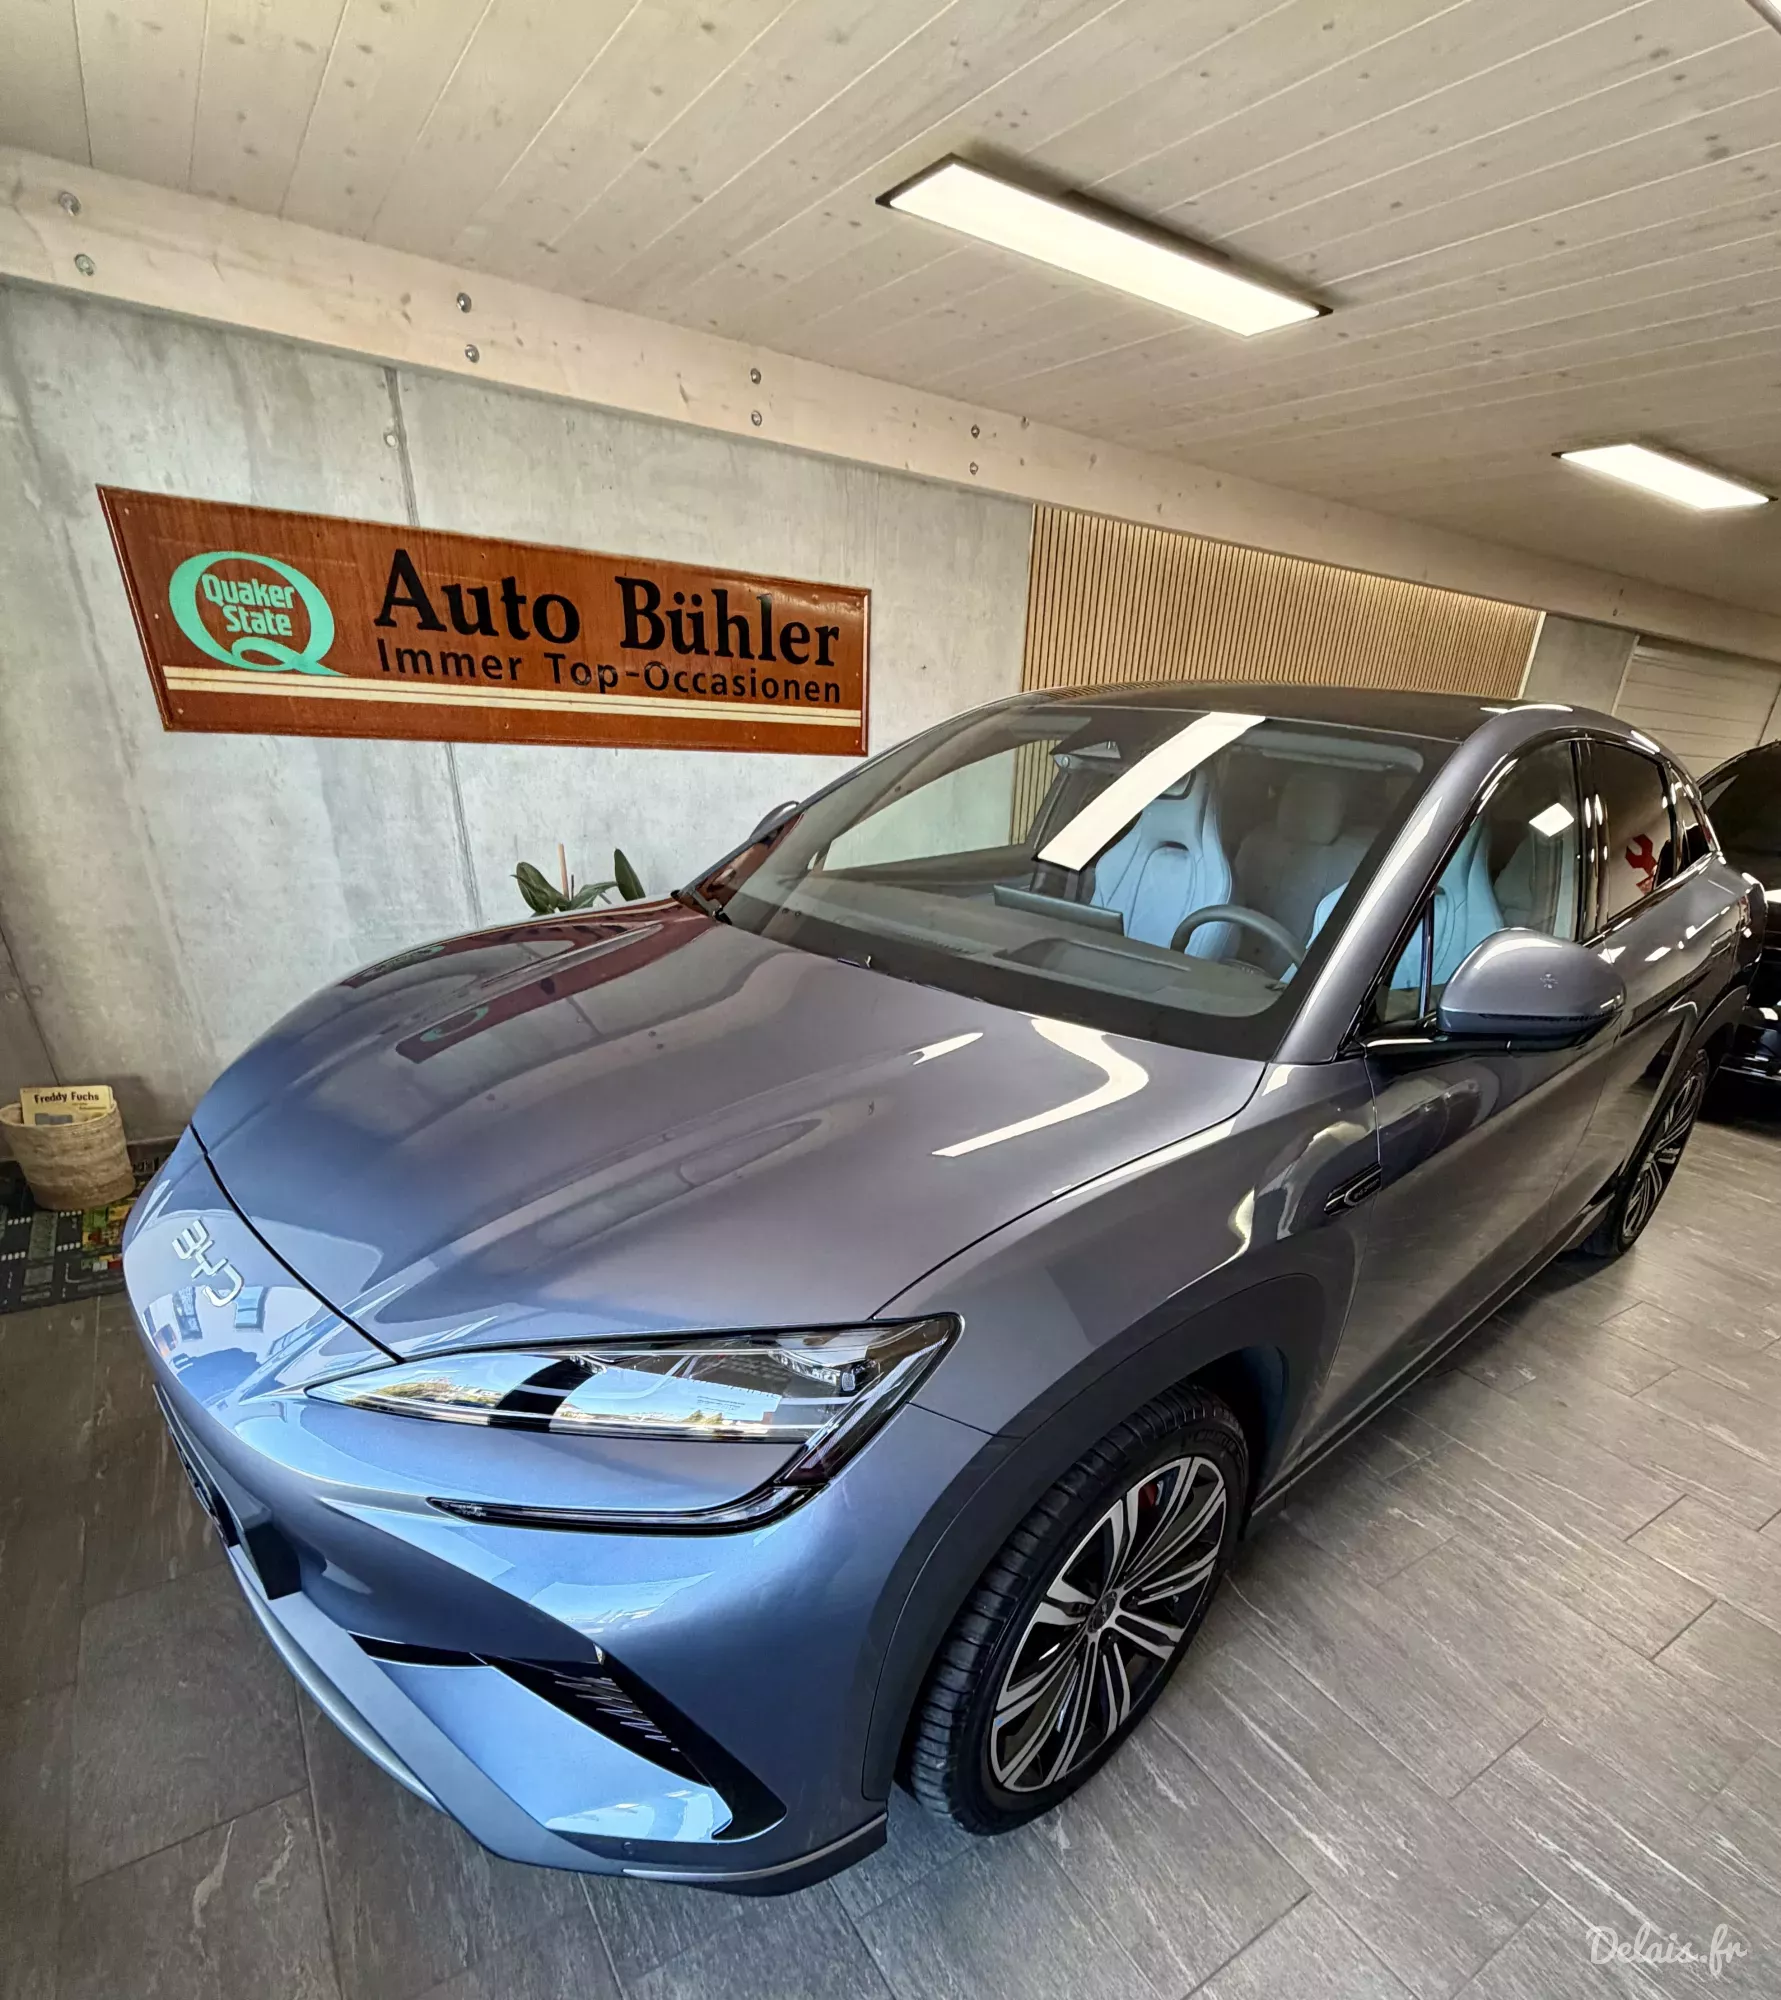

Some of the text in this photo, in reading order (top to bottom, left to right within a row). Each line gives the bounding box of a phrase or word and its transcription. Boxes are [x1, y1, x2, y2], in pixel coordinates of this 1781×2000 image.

[200, 573, 298, 610] Quaker
[374, 548, 840, 667] Auto Bühler
[222, 604, 293, 637] State
[376, 638, 841, 704] Immer Top-Occasionen
[34, 1091, 99, 1104] Freddy Fuchs
